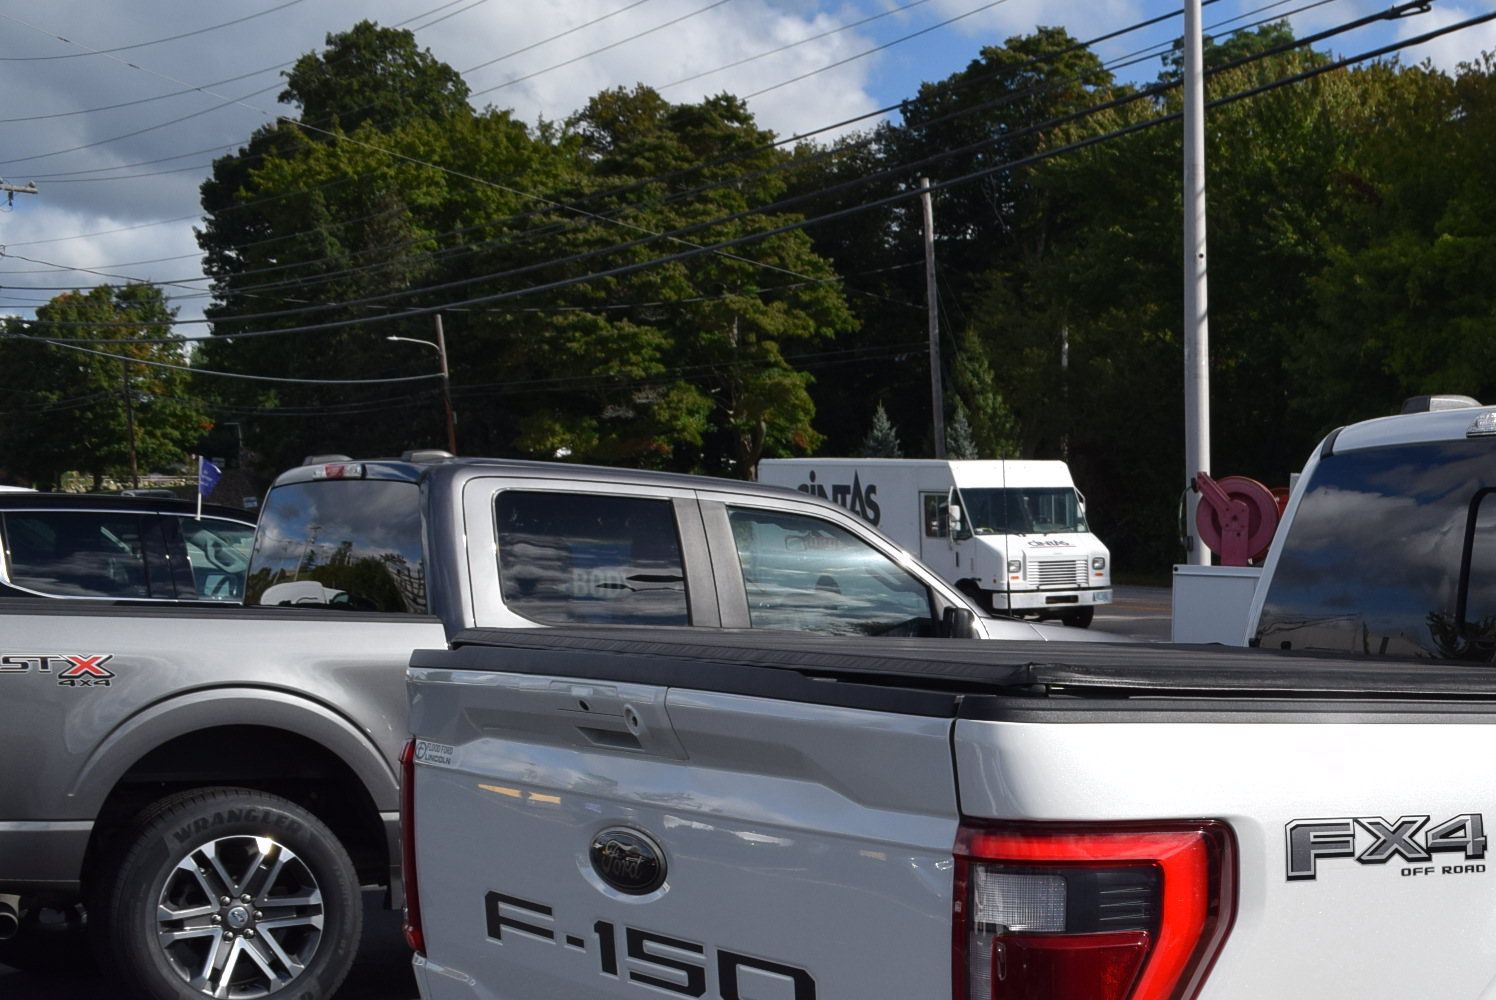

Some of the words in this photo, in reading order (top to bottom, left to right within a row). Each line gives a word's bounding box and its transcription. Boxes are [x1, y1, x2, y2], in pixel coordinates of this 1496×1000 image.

[798, 468, 881, 527] TAS
[0, 654, 116, 679] STX
[172, 808, 303, 843] WRANGLER
[1285, 813, 1488, 881] FX4
[1400, 866, 1436, 877] OFF
[1441, 864, 1487, 875] ROAD
